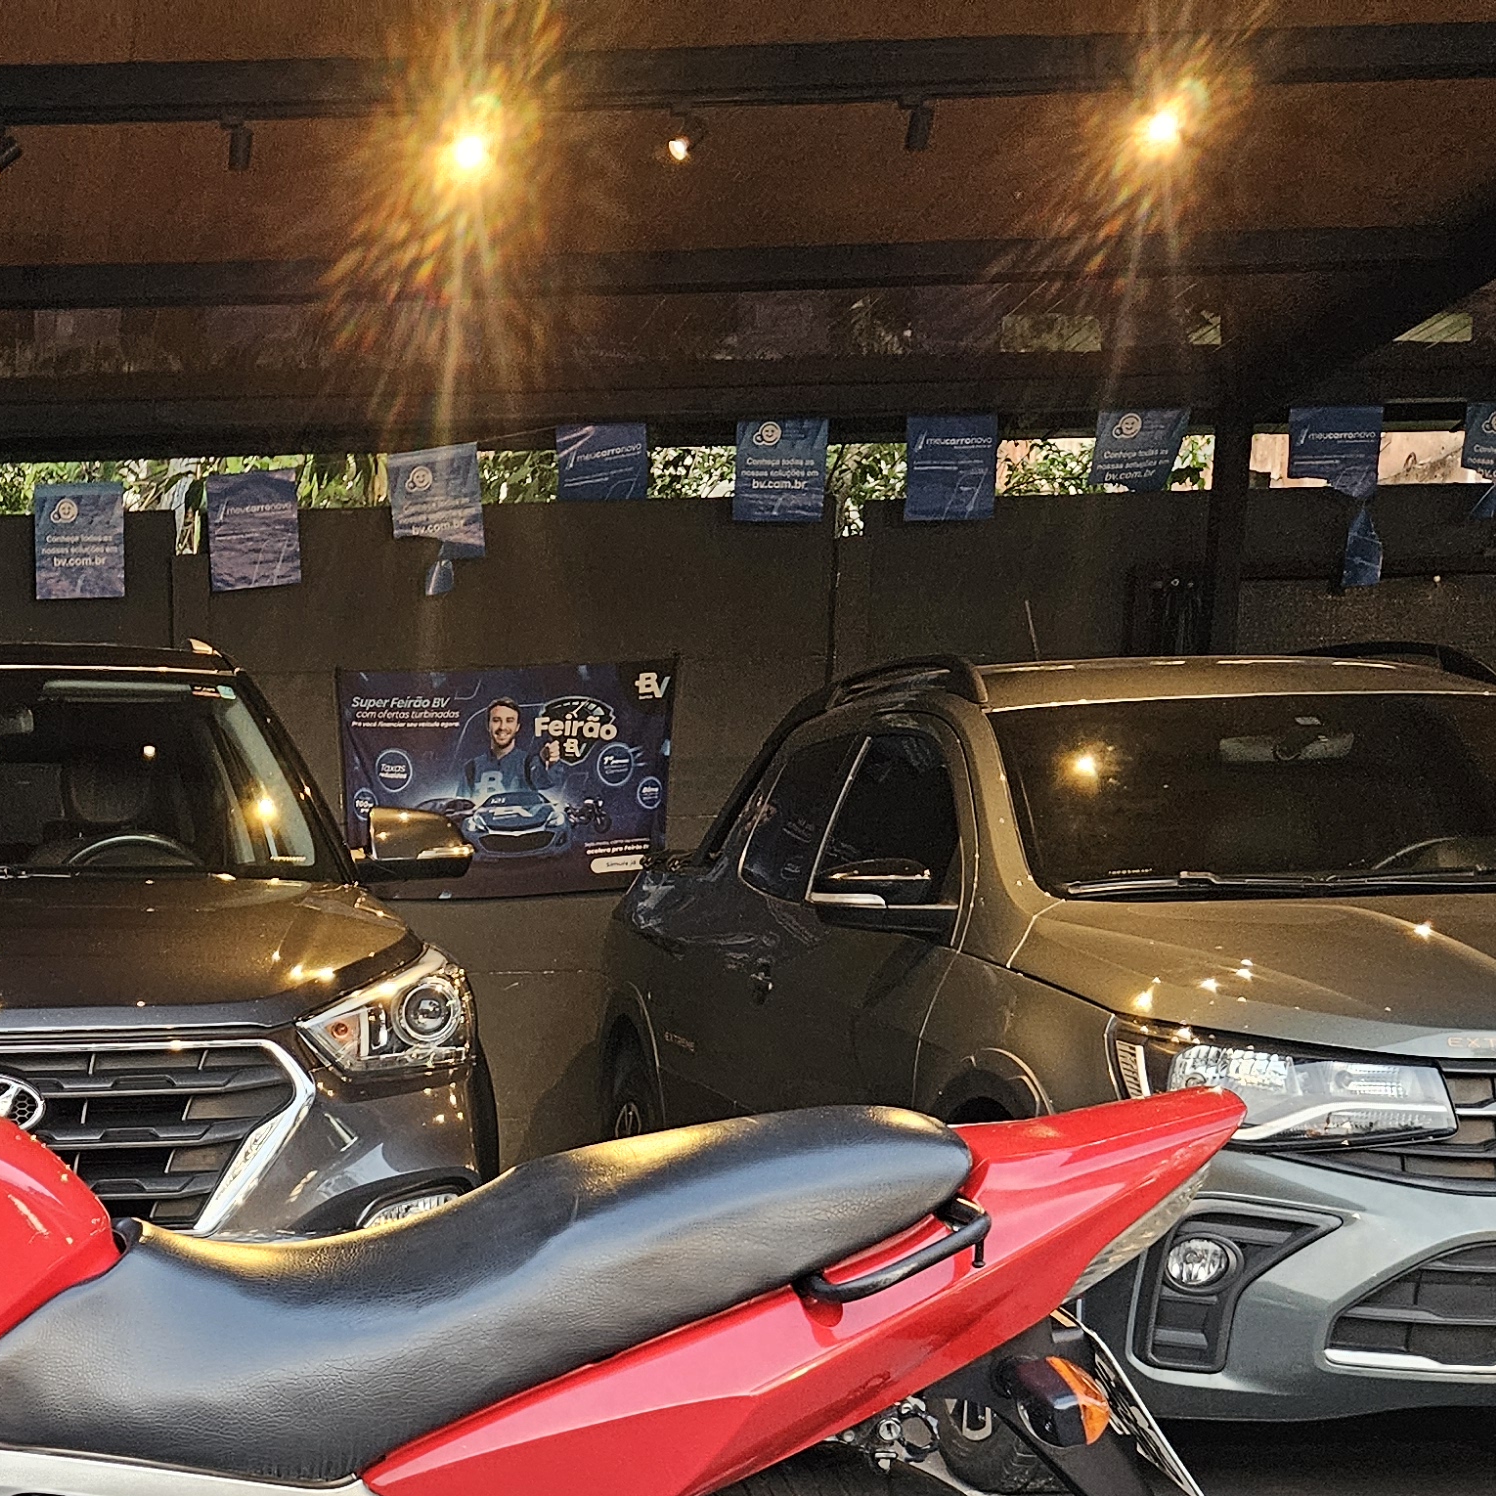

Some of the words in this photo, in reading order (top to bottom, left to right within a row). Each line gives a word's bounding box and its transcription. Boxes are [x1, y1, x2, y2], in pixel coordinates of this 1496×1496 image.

[752, 479, 808, 489] bv.com.br
[53, 556, 107, 567] bv.com.br
[351, 696, 390, 710] Super
[390, 696, 431, 708] Feirão
[431, 697, 451, 708] BV
[377, 709, 410, 719] ofertas
[411, 709, 460, 718] turbinadas
[534, 713, 618, 741] Feirão
[381, 763, 406, 772] Taxas
